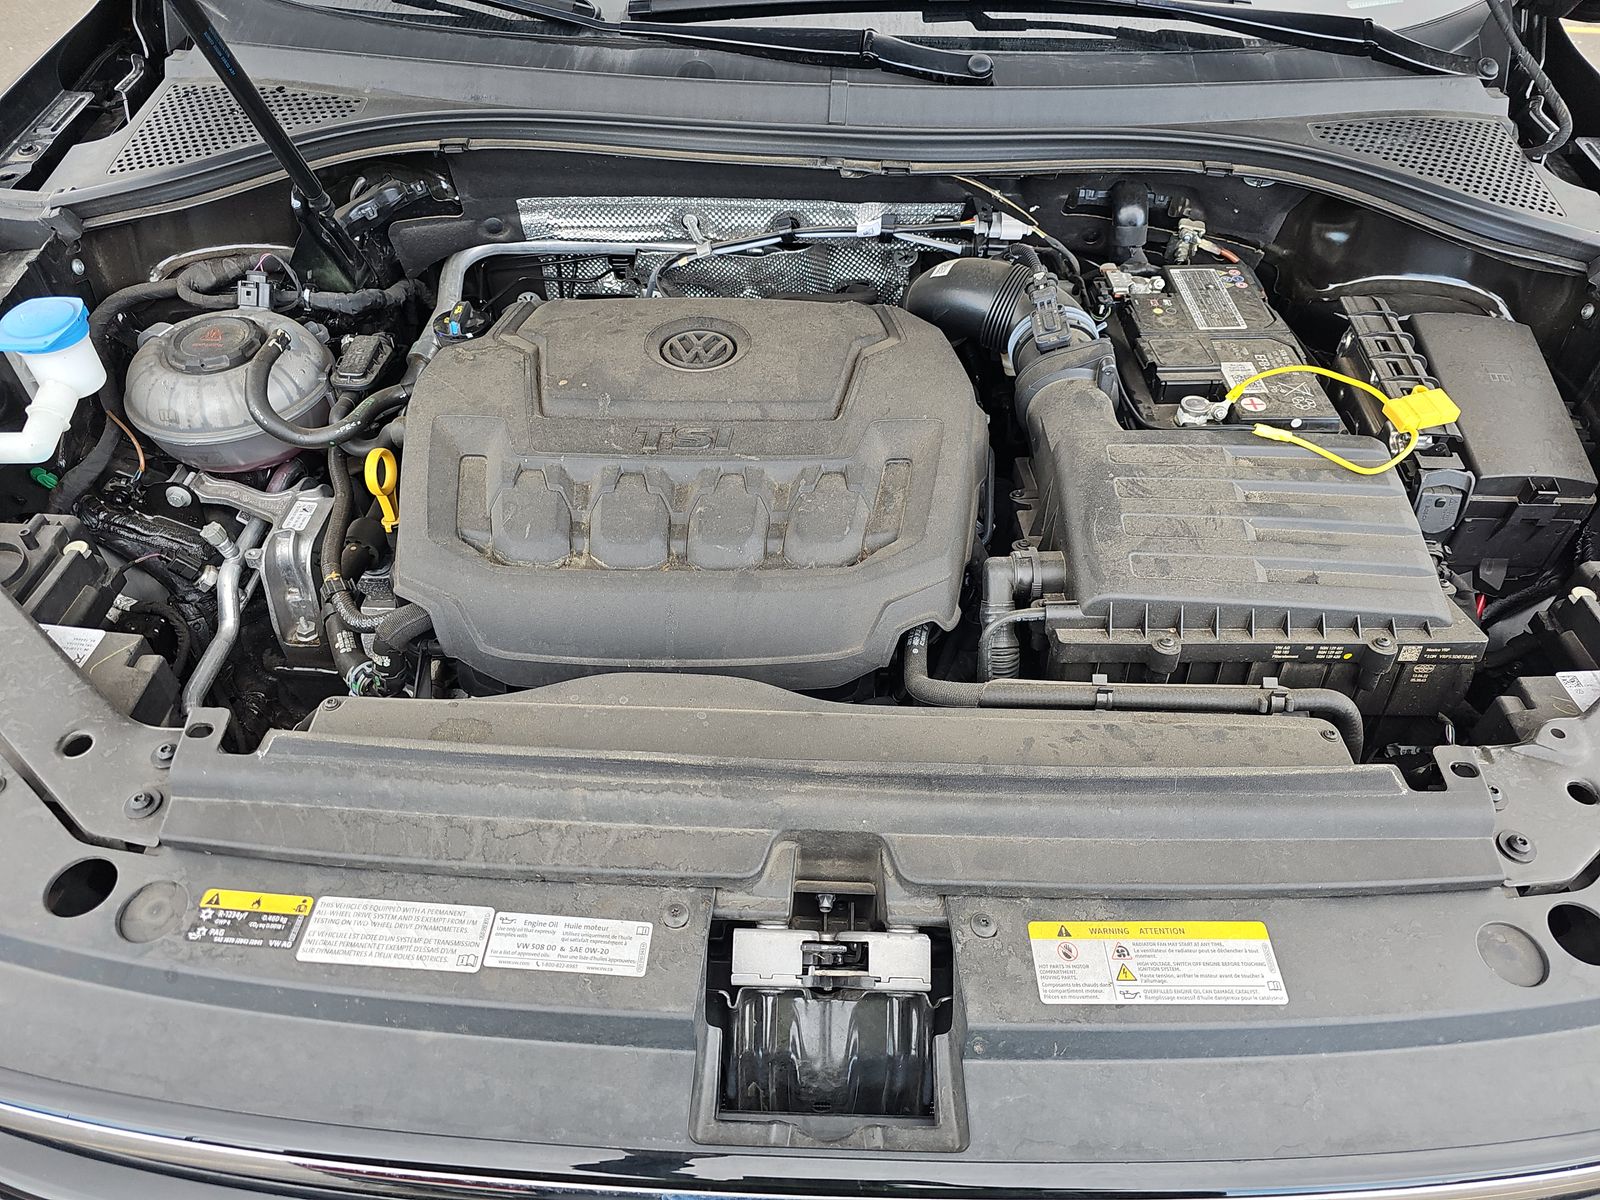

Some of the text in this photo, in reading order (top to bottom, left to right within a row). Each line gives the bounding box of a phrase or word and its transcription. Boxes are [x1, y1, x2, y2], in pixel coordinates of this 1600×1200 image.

[662, 330, 734, 369] VW
[632, 426, 735, 455] TSI
[369, 904, 402, 912] EQUIPPED
[427, 908, 466, 917] PERMANENT
[524, 920, 547, 928] Engine
[1089, 927, 1130, 935] WARNING
[434, 939, 480, 947] TRANSMISSION
[585, 947, 609, 955] 0W-20
